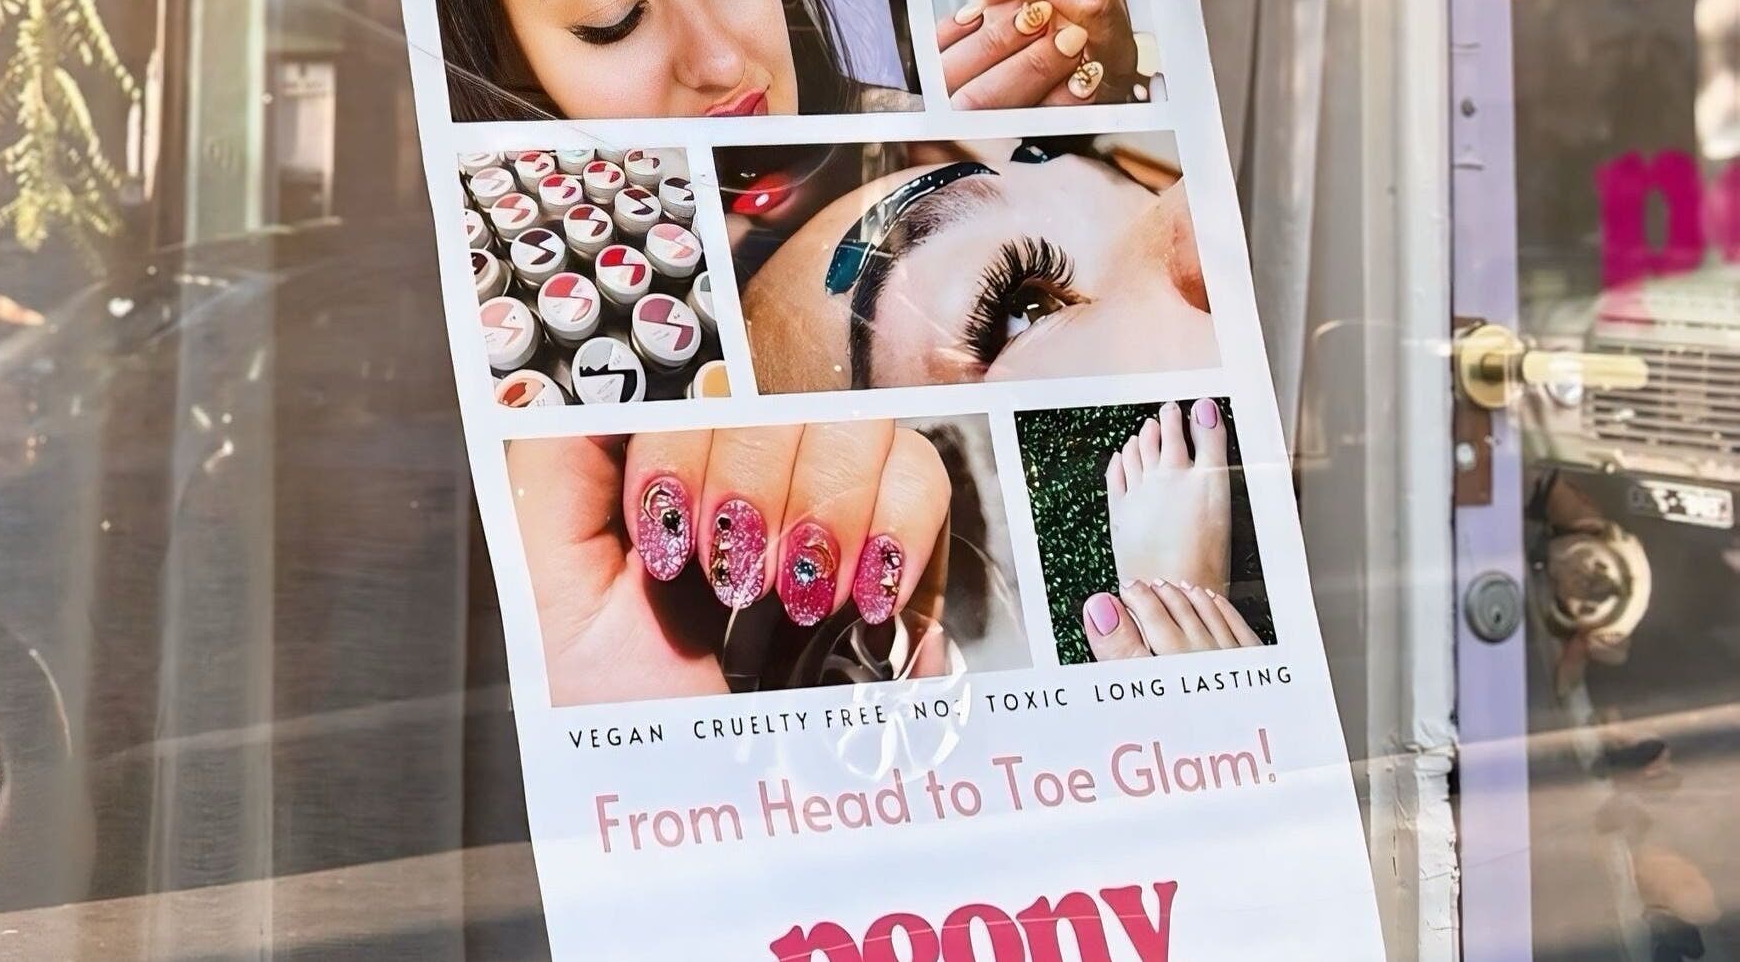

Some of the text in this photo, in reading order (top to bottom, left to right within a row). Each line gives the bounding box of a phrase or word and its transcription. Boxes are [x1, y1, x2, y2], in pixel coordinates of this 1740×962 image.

[568, 666, 1292, 750] VEGAN CRUELTY FREE NO TOXIC LONG LASTING
[595, 726, 1277, 854] From Head to Toe Glam!
[769, 879, 1179, 962] ony
